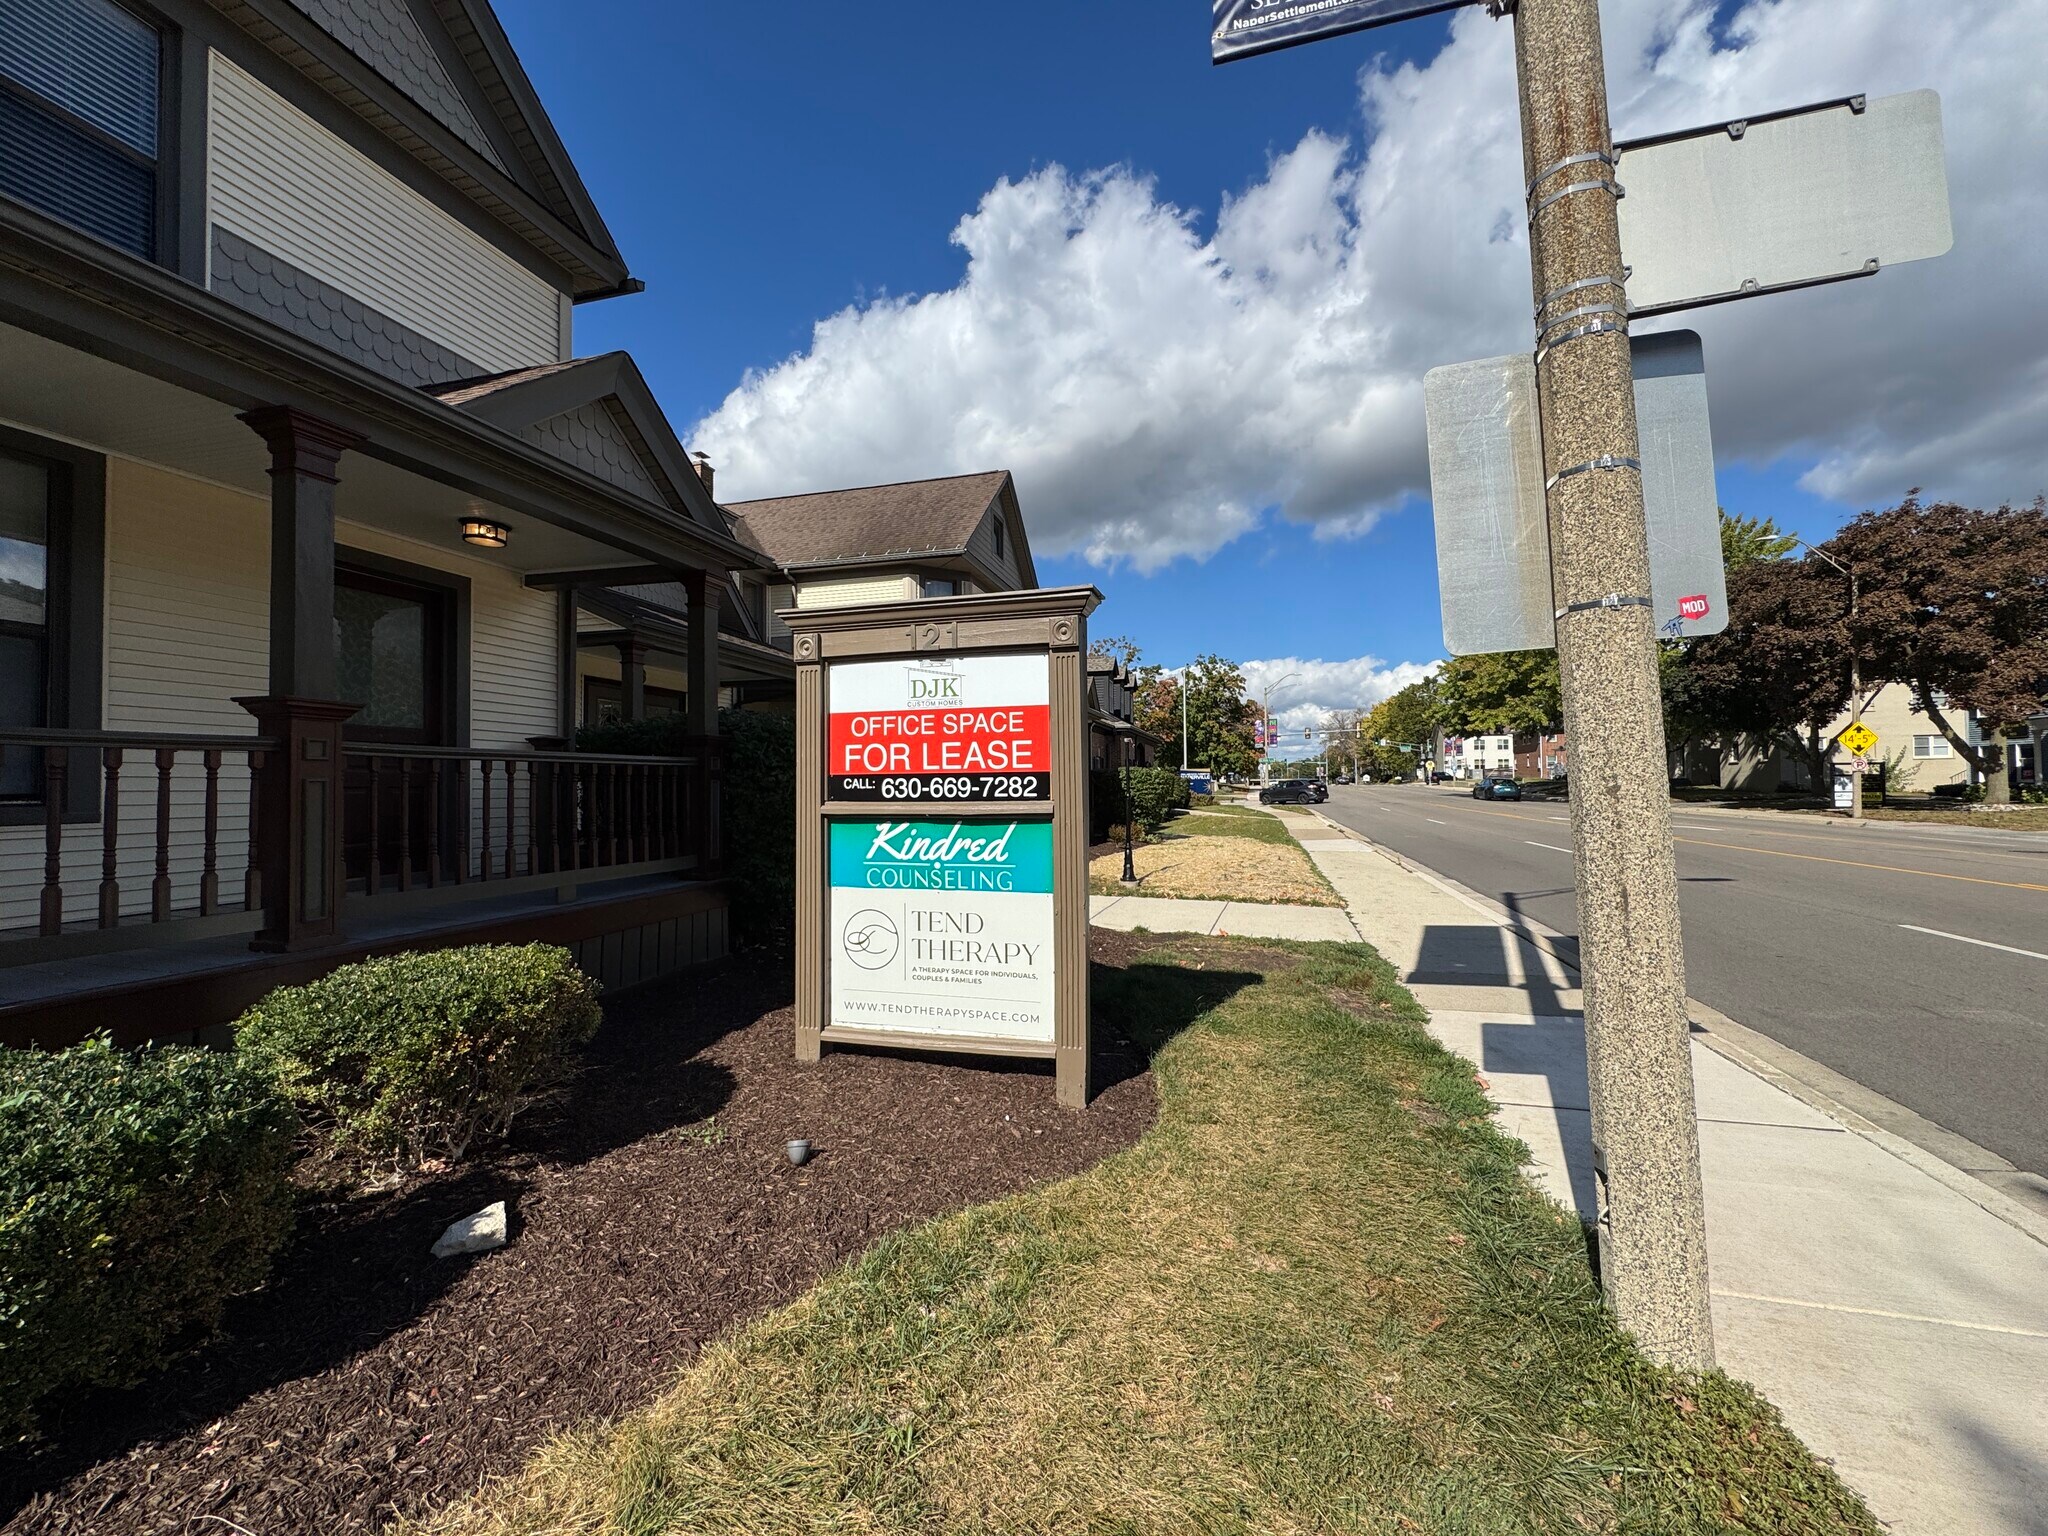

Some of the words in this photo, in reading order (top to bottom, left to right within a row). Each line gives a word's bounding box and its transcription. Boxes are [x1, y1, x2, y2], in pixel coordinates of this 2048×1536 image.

[1682, 600, 1705, 614] MOD
[905, 621, 957, 651] 121
[910, 678, 959, 699] DJK
[907, 700, 936, 708] CUSTOM
[938, 699, 963, 707] HOMES
[851, 714, 935, 738] OFFICE
[943, 711, 1025, 734] SPACE
[845, 743, 911, 772] FOR
[922, 739, 1033, 771] LEASE
[843, 777, 876, 790] CALL:
[881, 776, 1038, 799] 630-669-7282
[866, 820, 1018, 862] Kindred
[866, 867, 1013, 891] COUNSELING
[911, 910, 984, 934] TEND
[911, 938, 1040, 966] THERAPY
[912, 974, 944, 982] COUPLES
[951, 977, 983, 985] FAMILIES
[919, 966, 951, 974] THERAPY
[951, 968, 974, 976] SPACE
[991, 970, 1039, 981] INDIVIDUALS,
[844, 1000, 1040, 1024] WWW.TENDTHERAPYSPACE.COM
